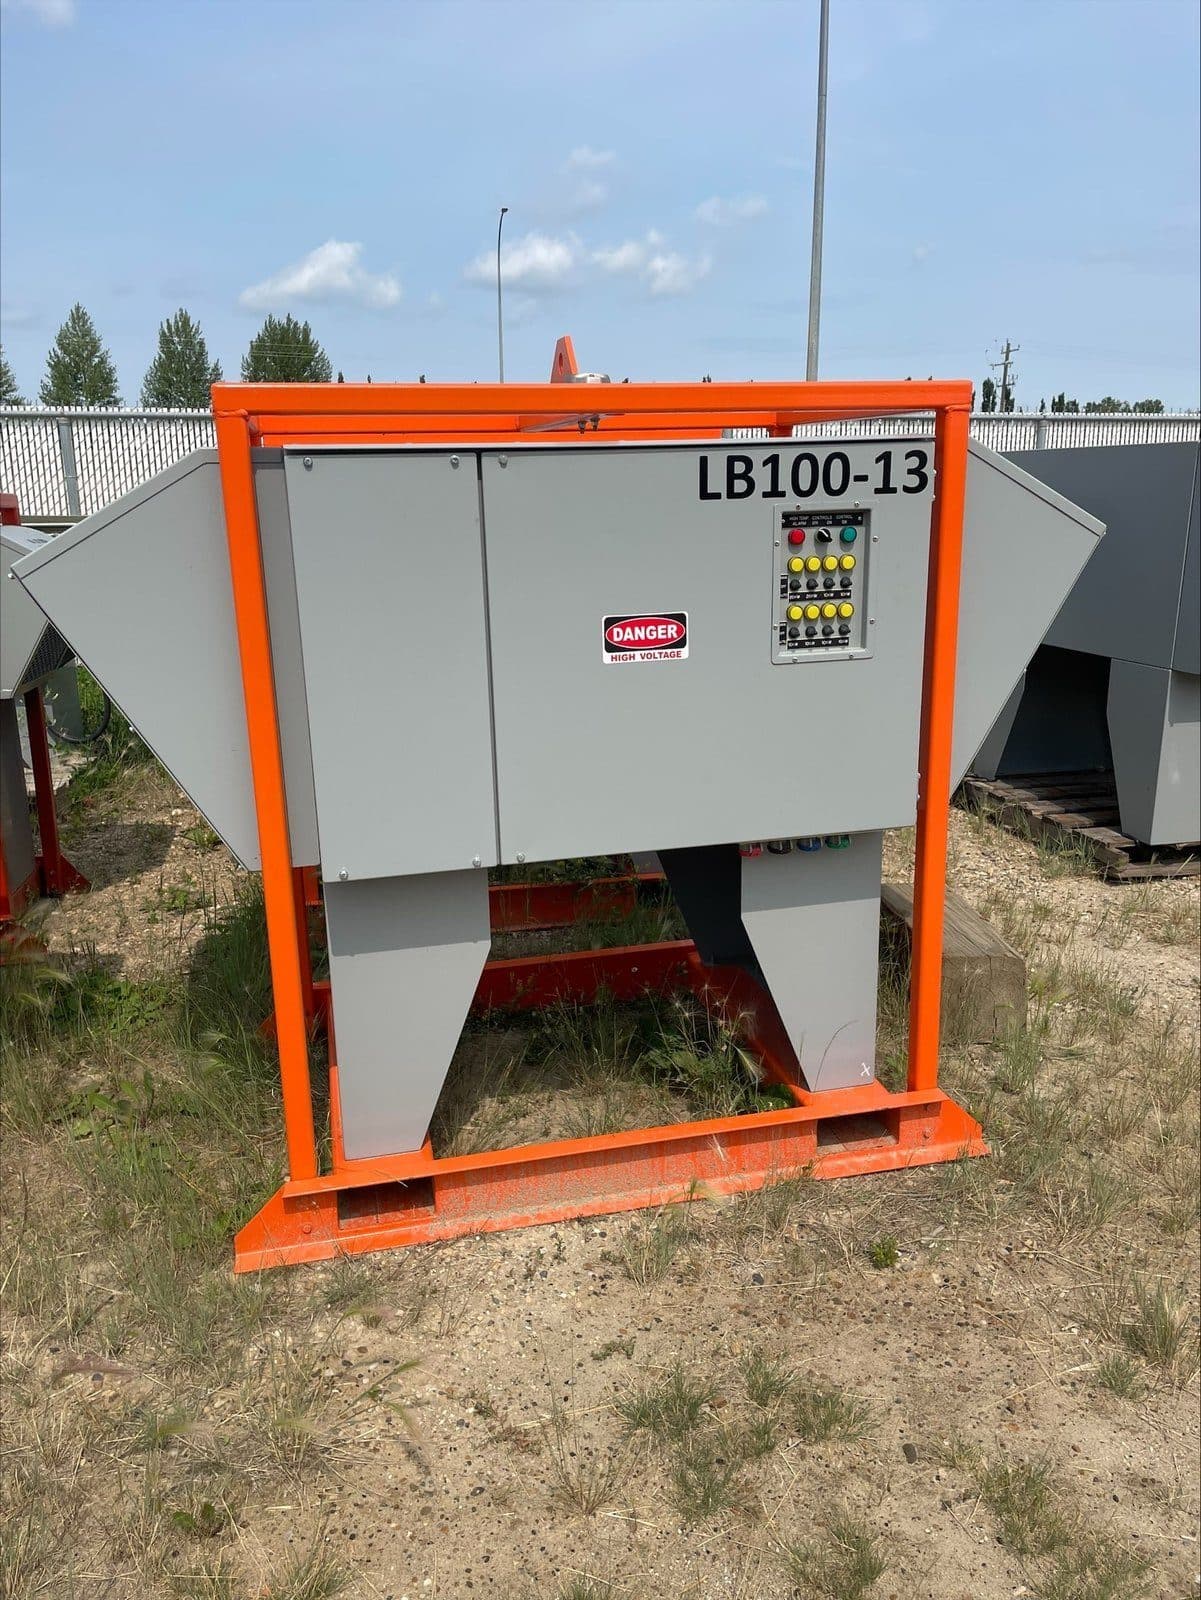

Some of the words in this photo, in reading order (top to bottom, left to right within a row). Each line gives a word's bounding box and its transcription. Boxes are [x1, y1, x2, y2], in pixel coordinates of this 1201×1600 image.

[699, 449, 929, 500] LB100-13
[612, 624, 678, 642] DANGER
[610, 653, 636, 662] HIGH
[640, 650, 683, 660] VOLTAGE
